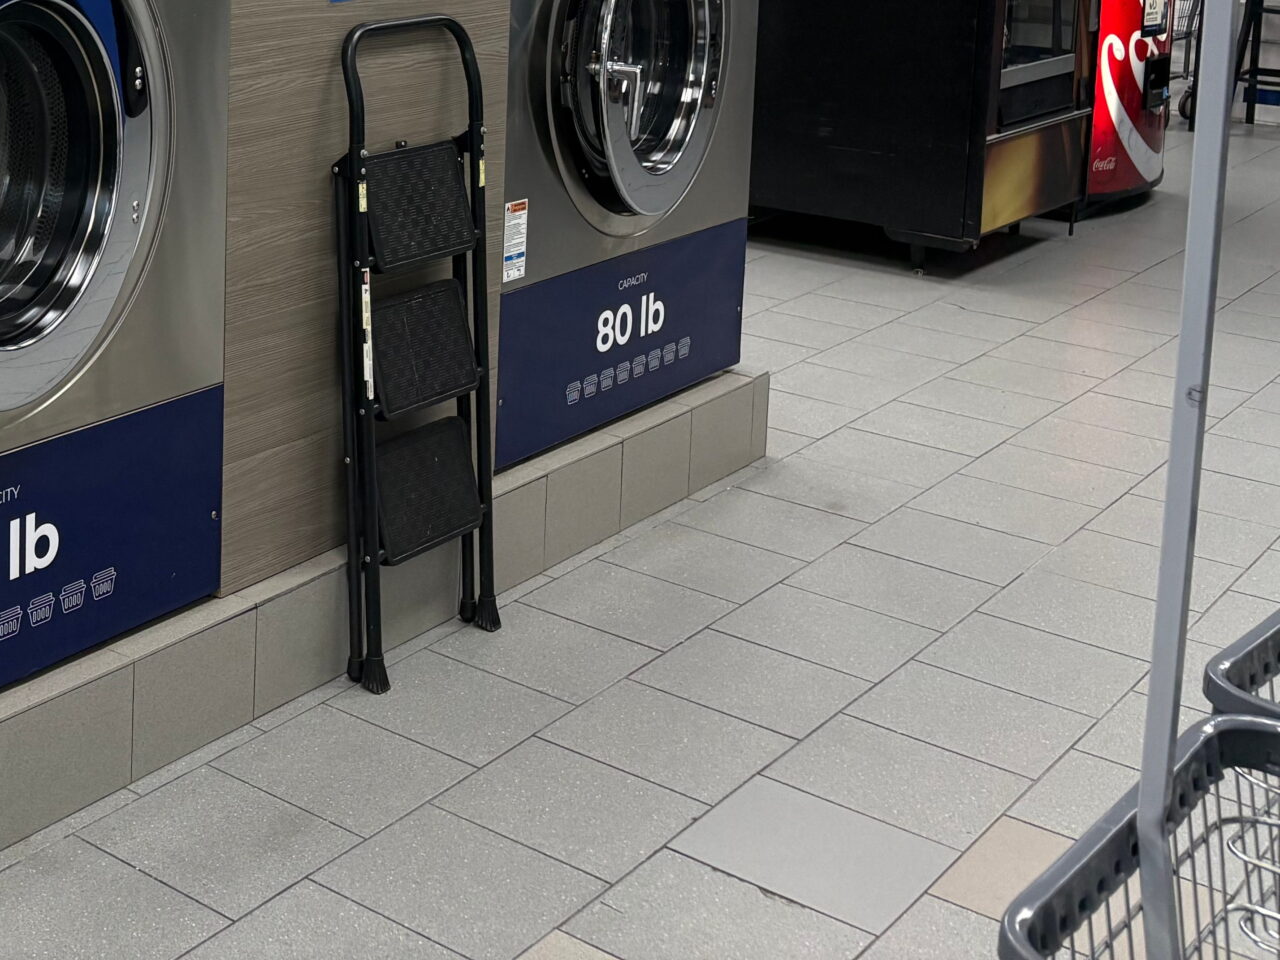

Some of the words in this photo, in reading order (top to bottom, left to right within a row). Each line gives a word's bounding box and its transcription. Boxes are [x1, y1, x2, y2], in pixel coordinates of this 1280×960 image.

[618, 271, 649, 291] CAPACITY
[595, 303, 633, 353] 80
[640, 292, 666, 338] lb
[9, 511, 60, 582] lb
